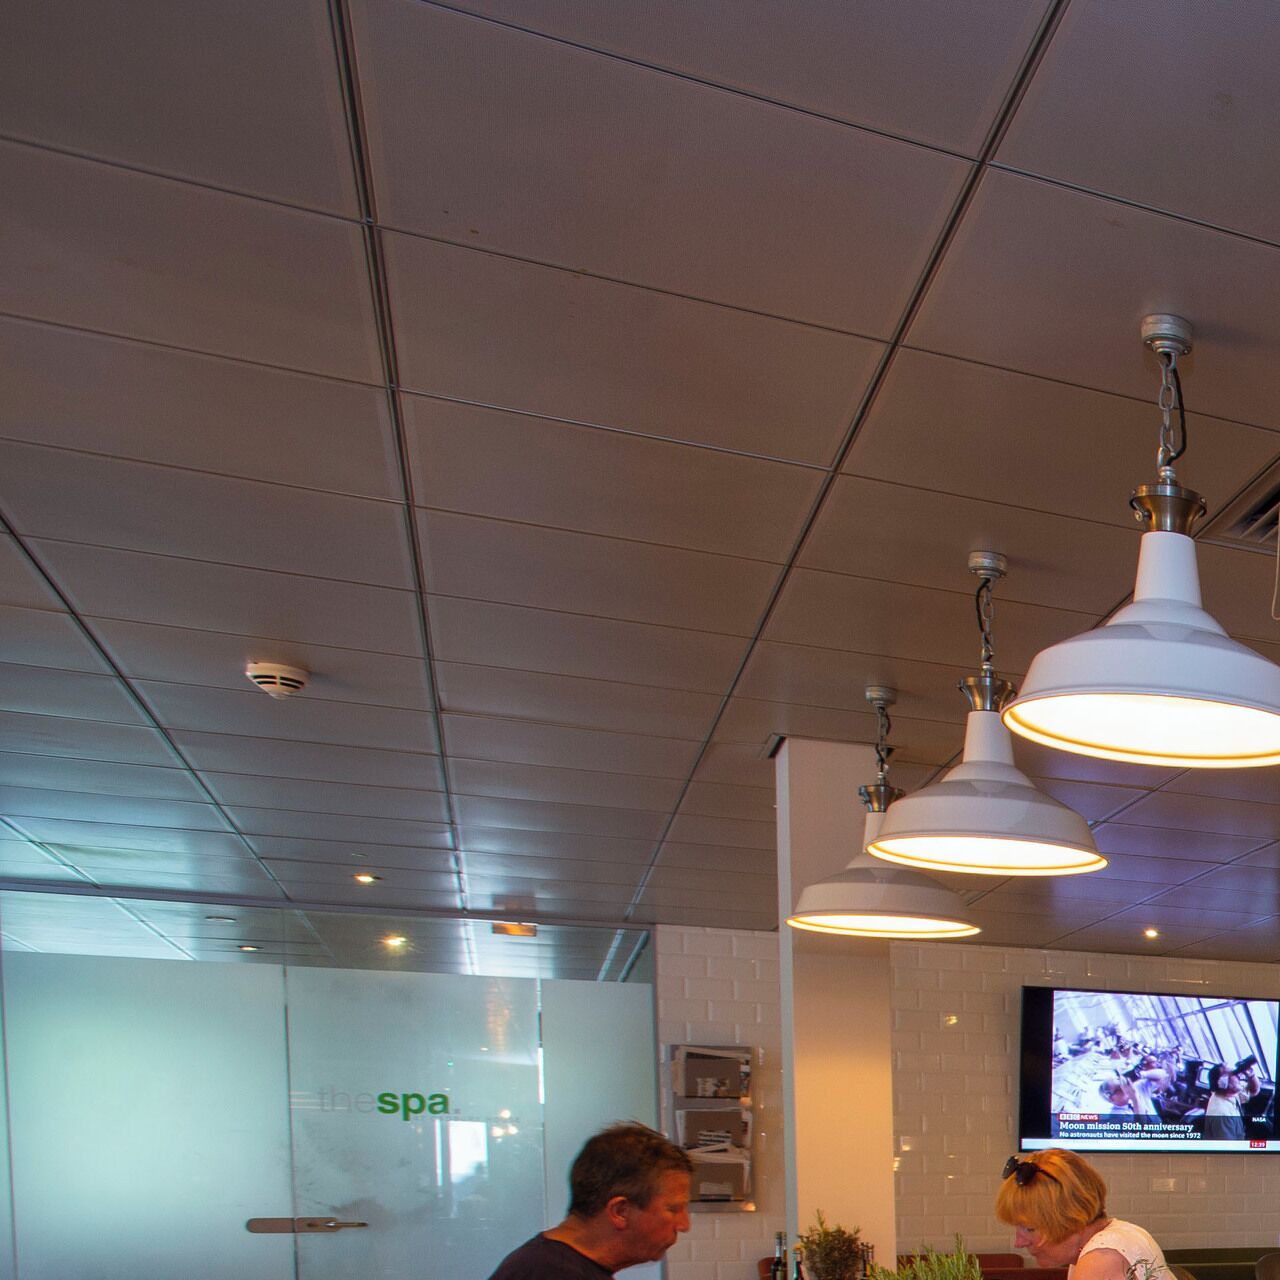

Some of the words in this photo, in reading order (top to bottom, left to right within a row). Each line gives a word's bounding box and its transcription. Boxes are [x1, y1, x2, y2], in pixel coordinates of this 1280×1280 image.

[1059, 1122, 1086, 1131] Moon
[1086, 1122, 1121, 1131] mission
[1122, 1122, 1143, 1131] 50th
[1143, 1122, 1194, 1133] anniversary
[1103, 1131, 1119, 1139] have
